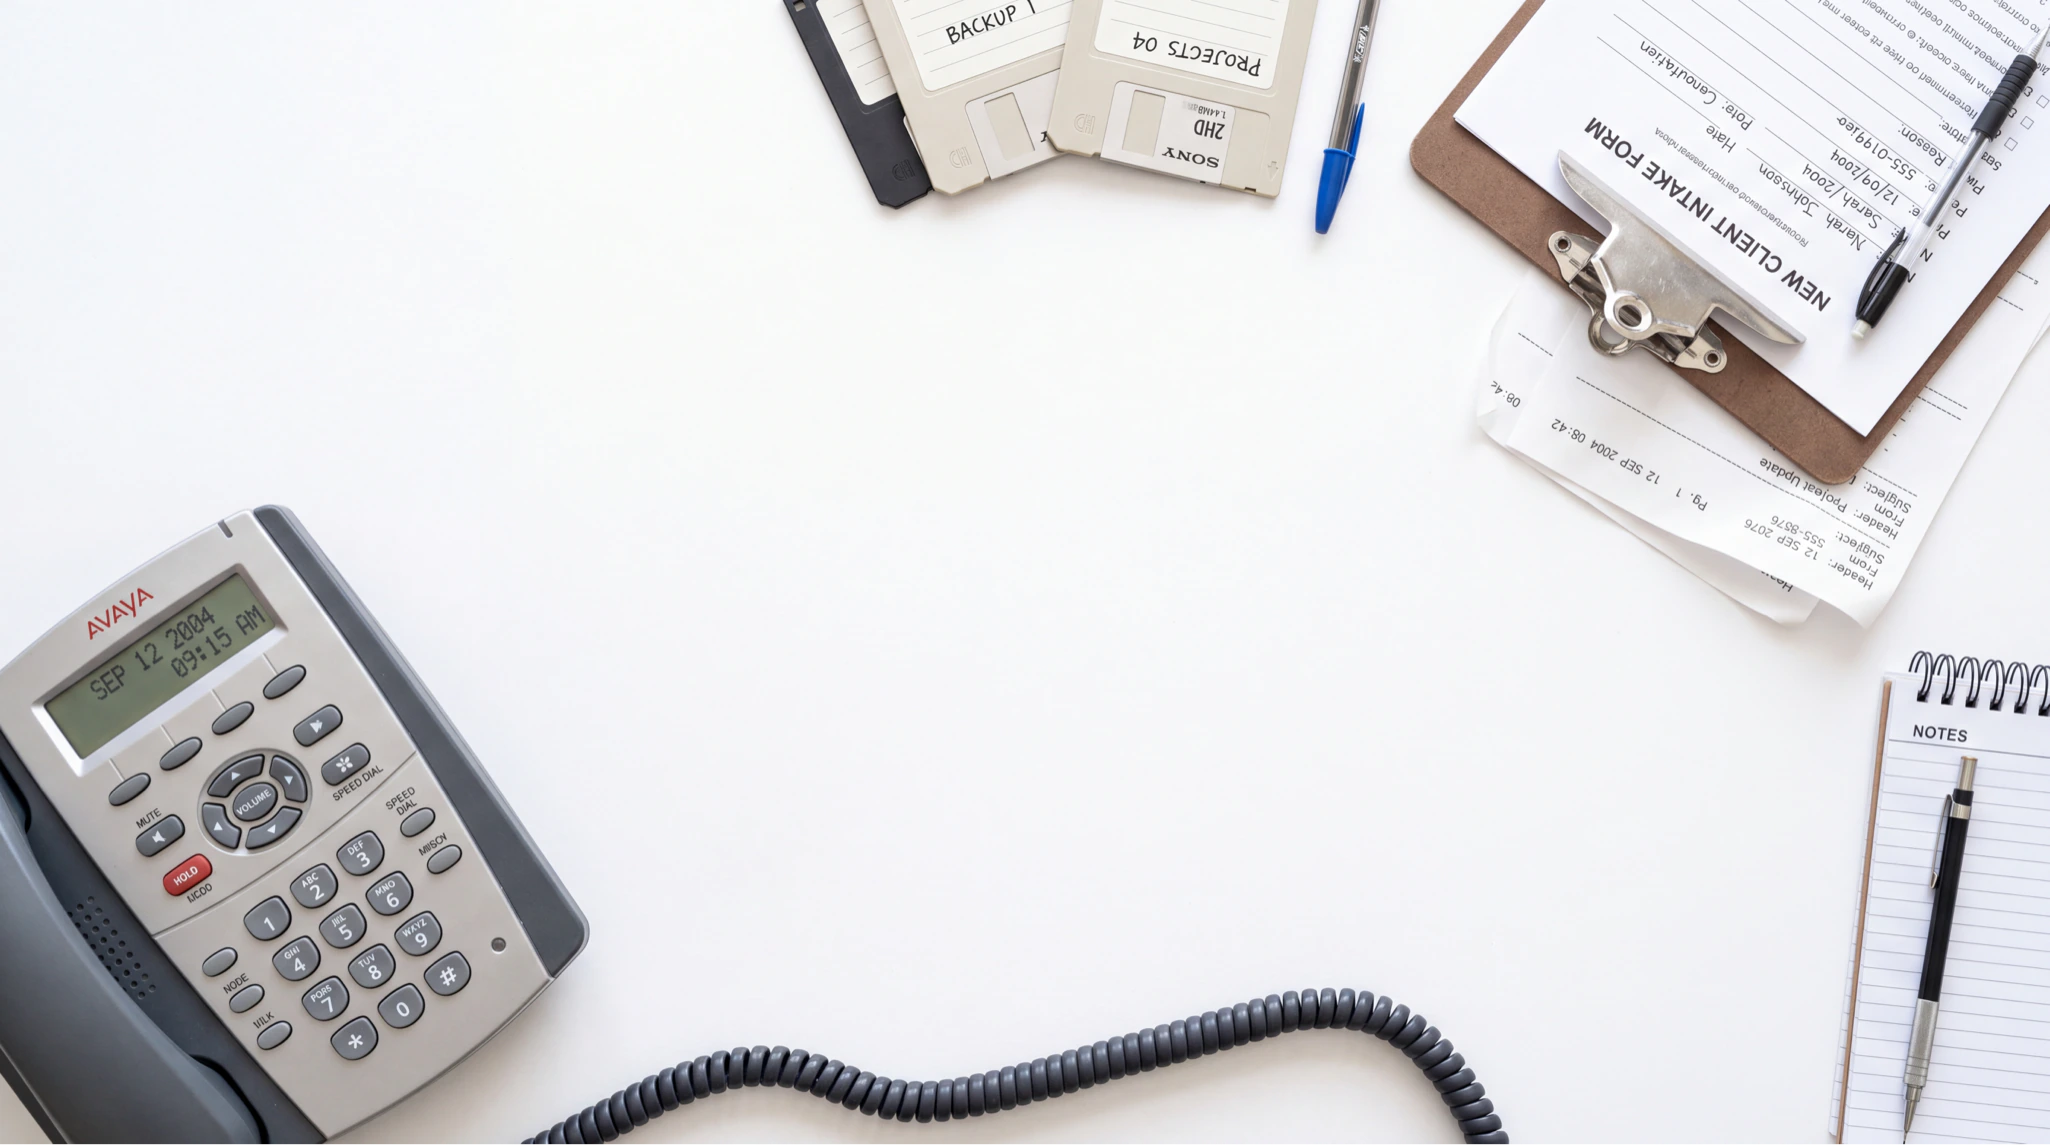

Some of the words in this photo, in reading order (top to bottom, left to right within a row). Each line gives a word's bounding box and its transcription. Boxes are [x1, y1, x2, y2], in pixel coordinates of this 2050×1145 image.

[946, 5, 1016, 44] BACKUP
[1132, 31, 1158, 53] 04
[1168, 41, 1261, 76] PROJECTS
[1193, 119, 1226, 141] 2HD
[1706, 126, 1736, 153] Hate
[1585, 117, 1644, 168] FORM
[1161, 146, 1220, 169] SONY
[1831, 149, 1902, 205] 12/09/2004
[1641, 161, 1714, 222] INTAKE
[1711, 217, 1782, 273] CLIENT
[1781, 270, 1831, 311] NEW
[1552, 419, 1586, 443] 08:42
[1589, 439, 1619, 461] 2004
[1619, 458, 1644, 475] SEP
[1645, 470, 1660, 485] 12
[1760, 458, 1805, 487] Update
[1675, 487, 1682, 498] 1
[1690, 492, 1708, 512] Pg.
[1854, 510, 1898, 540] Header:
[1875, 504, 1904, 527] From
[1743, 518, 1774, 539] 2076
[1776, 535, 1801, 552] SEP
[1804, 546, 1818, 561] 12
[1828, 559, 1873, 590] Header:
[1849, 555, 1878, 577] From
[88, 588, 153, 640] AVAYA
[171, 626, 232, 678] 09:15
[236, 605, 266, 635] AM
[90, 665, 125, 700] SEP
[135, 643, 163, 671] 12
[165, 606, 215, 650] 2004
[1912, 724, 1968, 743] NOTES
[333, 778, 362, 801] SPEED
[361, 765, 384, 783] DIAL
[237, 786, 271, 815] VOLUME
[386, 787, 415, 810] SPEED
[395, 799, 418, 816] DIAL
[135, 807, 162, 829] MUTE
[346, 839, 364, 856] DEF
[356, 851, 371, 868] 3
[173, 865, 199, 886] HOLD
[301, 872, 319, 888] ABC
[309, 884, 325, 901] 2
[386, 892, 400, 908] 6
[263, 917, 276, 931] 1
[338, 923, 353, 941] 5
[414, 932, 428, 948] 9
[294, 957, 306, 972] 4
[357, 953, 375, 968] TUV
[222, 972, 249, 995] NODE
[368, 964, 382, 981] 8
[320, 996, 334, 1013] 7
[396, 1001, 410, 1017] 0
